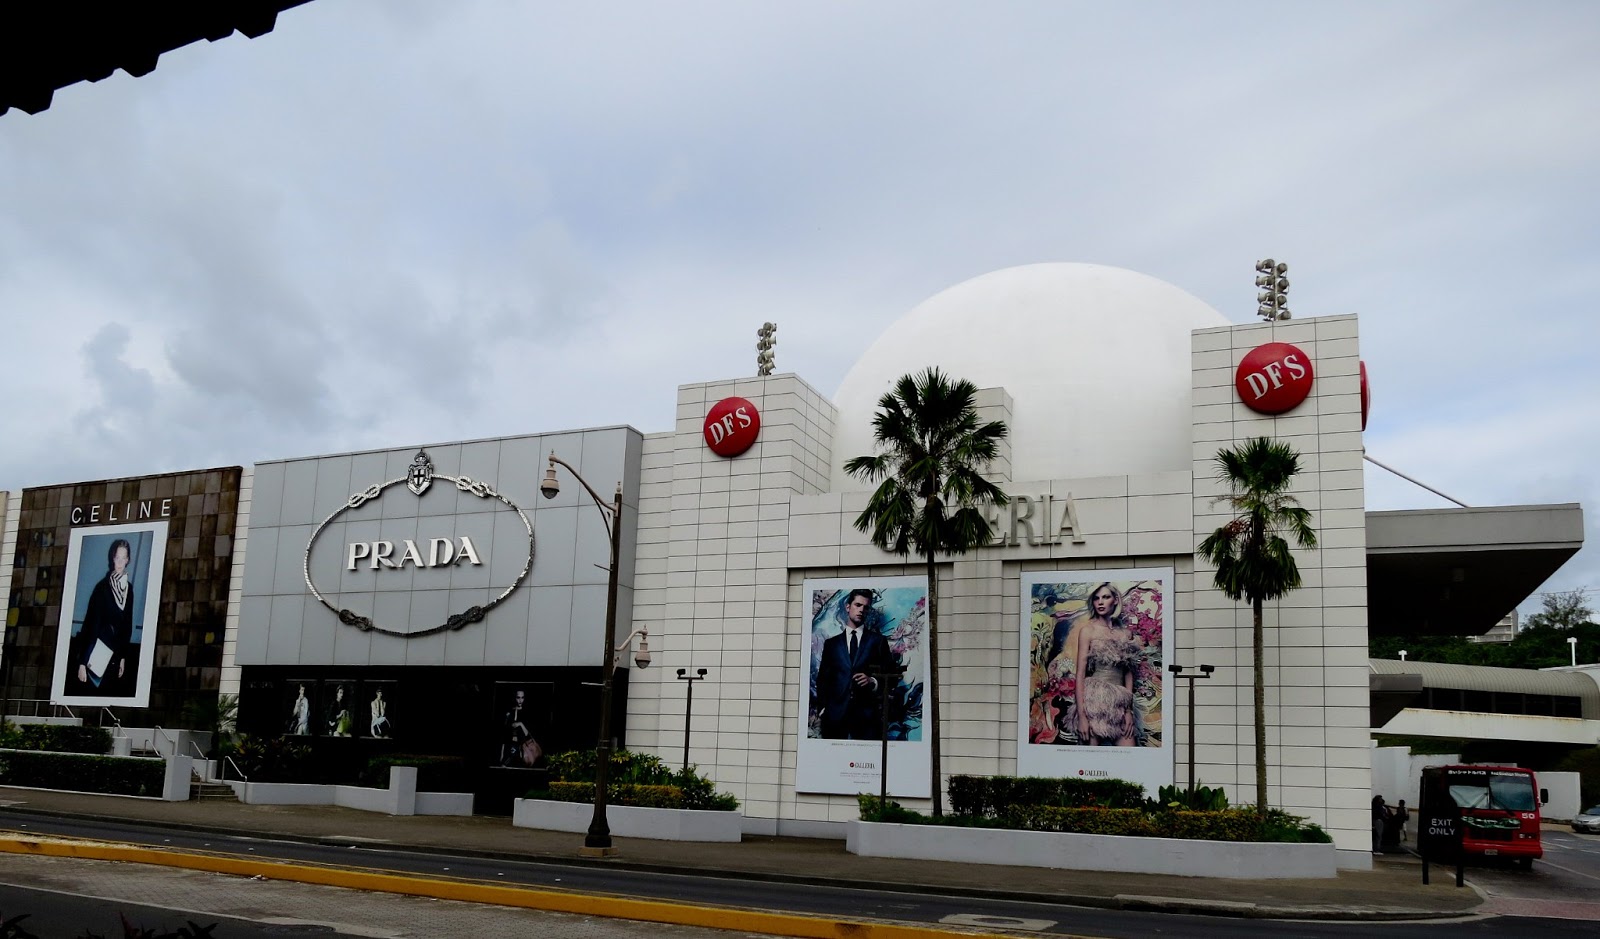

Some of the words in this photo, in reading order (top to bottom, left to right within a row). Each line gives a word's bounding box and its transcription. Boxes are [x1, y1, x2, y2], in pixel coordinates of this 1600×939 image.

[1244, 354, 1306, 400] DFS
[708, 406, 752, 446] DFS
[71, 498, 172, 524] CELINE
[347, 536, 482, 570] PRADA
[1428, 827, 1456, 836] ONLY
[1431, 818, 1453, 826] EXIT
